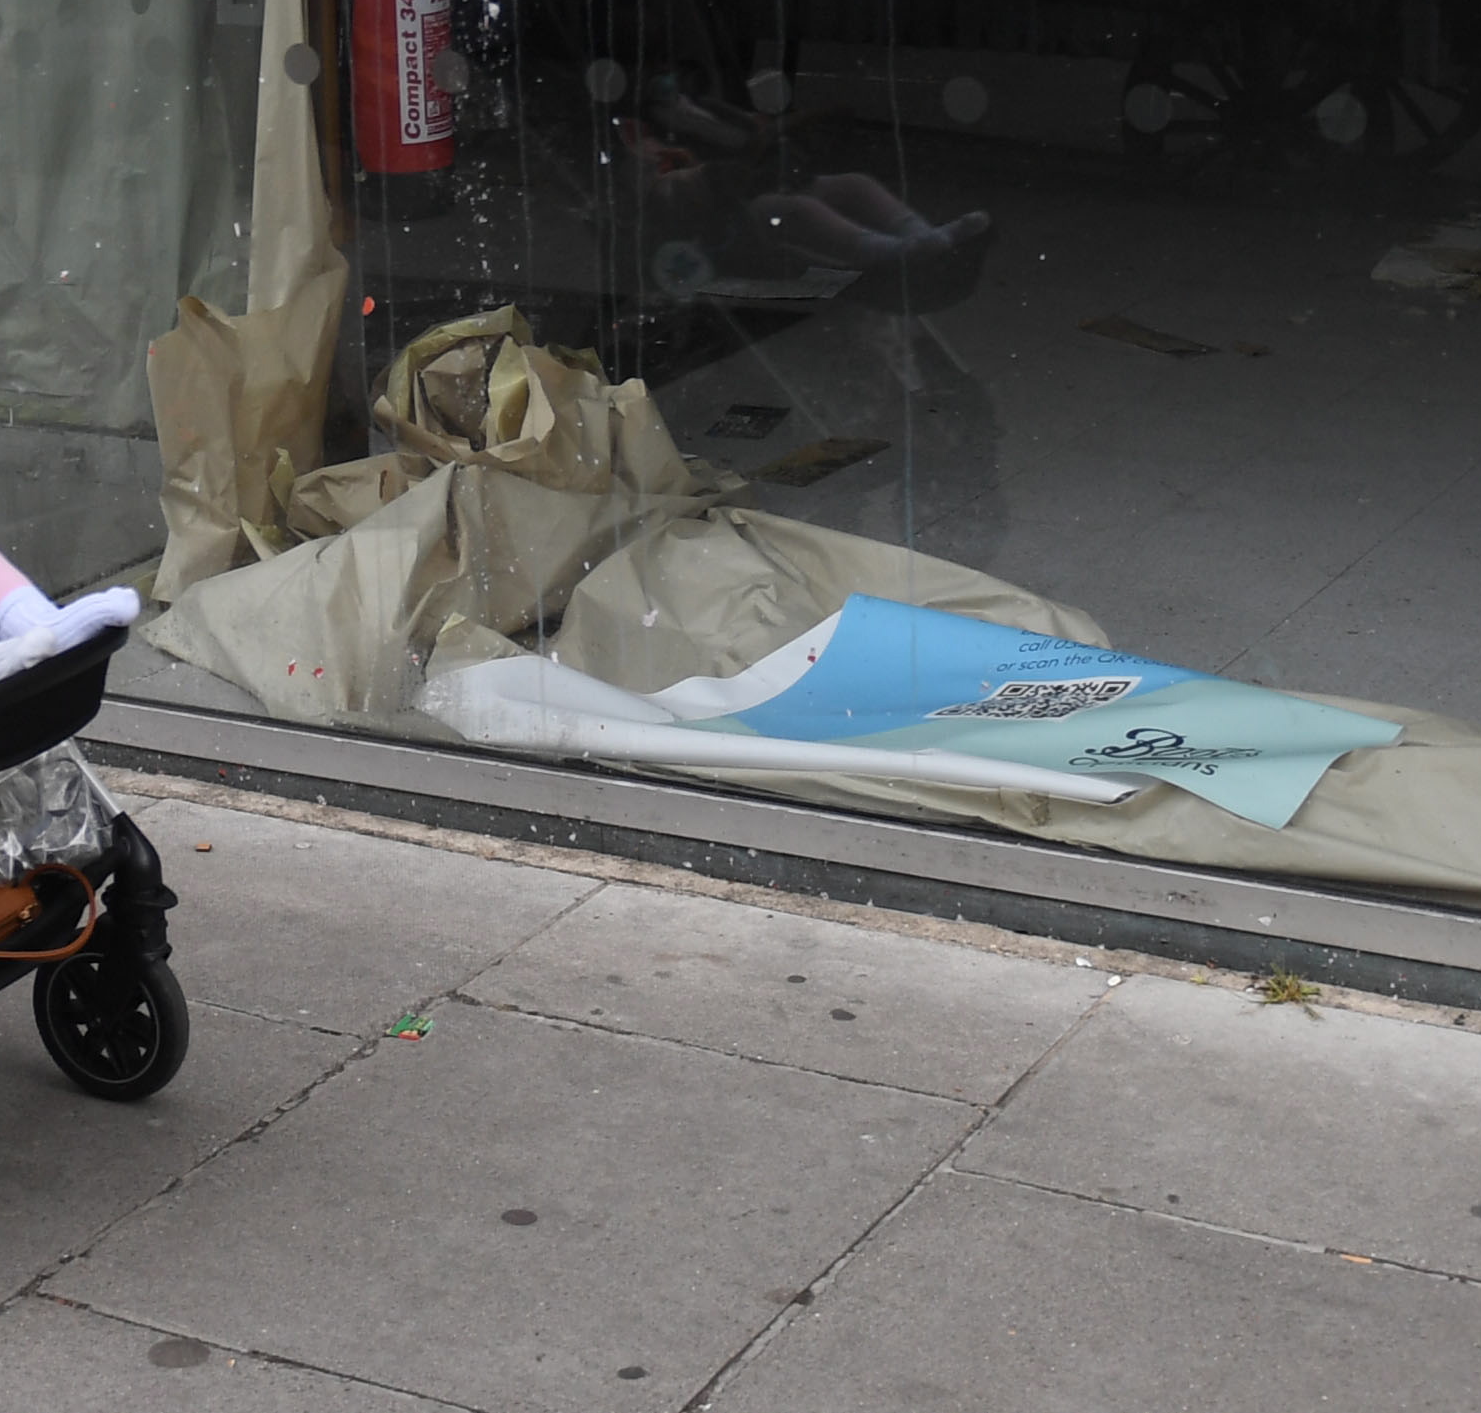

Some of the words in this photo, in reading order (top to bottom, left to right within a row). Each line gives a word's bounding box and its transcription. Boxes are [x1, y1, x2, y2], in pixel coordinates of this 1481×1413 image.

[403, 31, 423, 140] Compact
[1019, 639, 1052, 653] call
[996, 661, 1013, 672] or
[1017, 658, 1058, 671] scan
[1063, 652, 1093, 667] the
[1084, 727, 1263, 761] Boots
